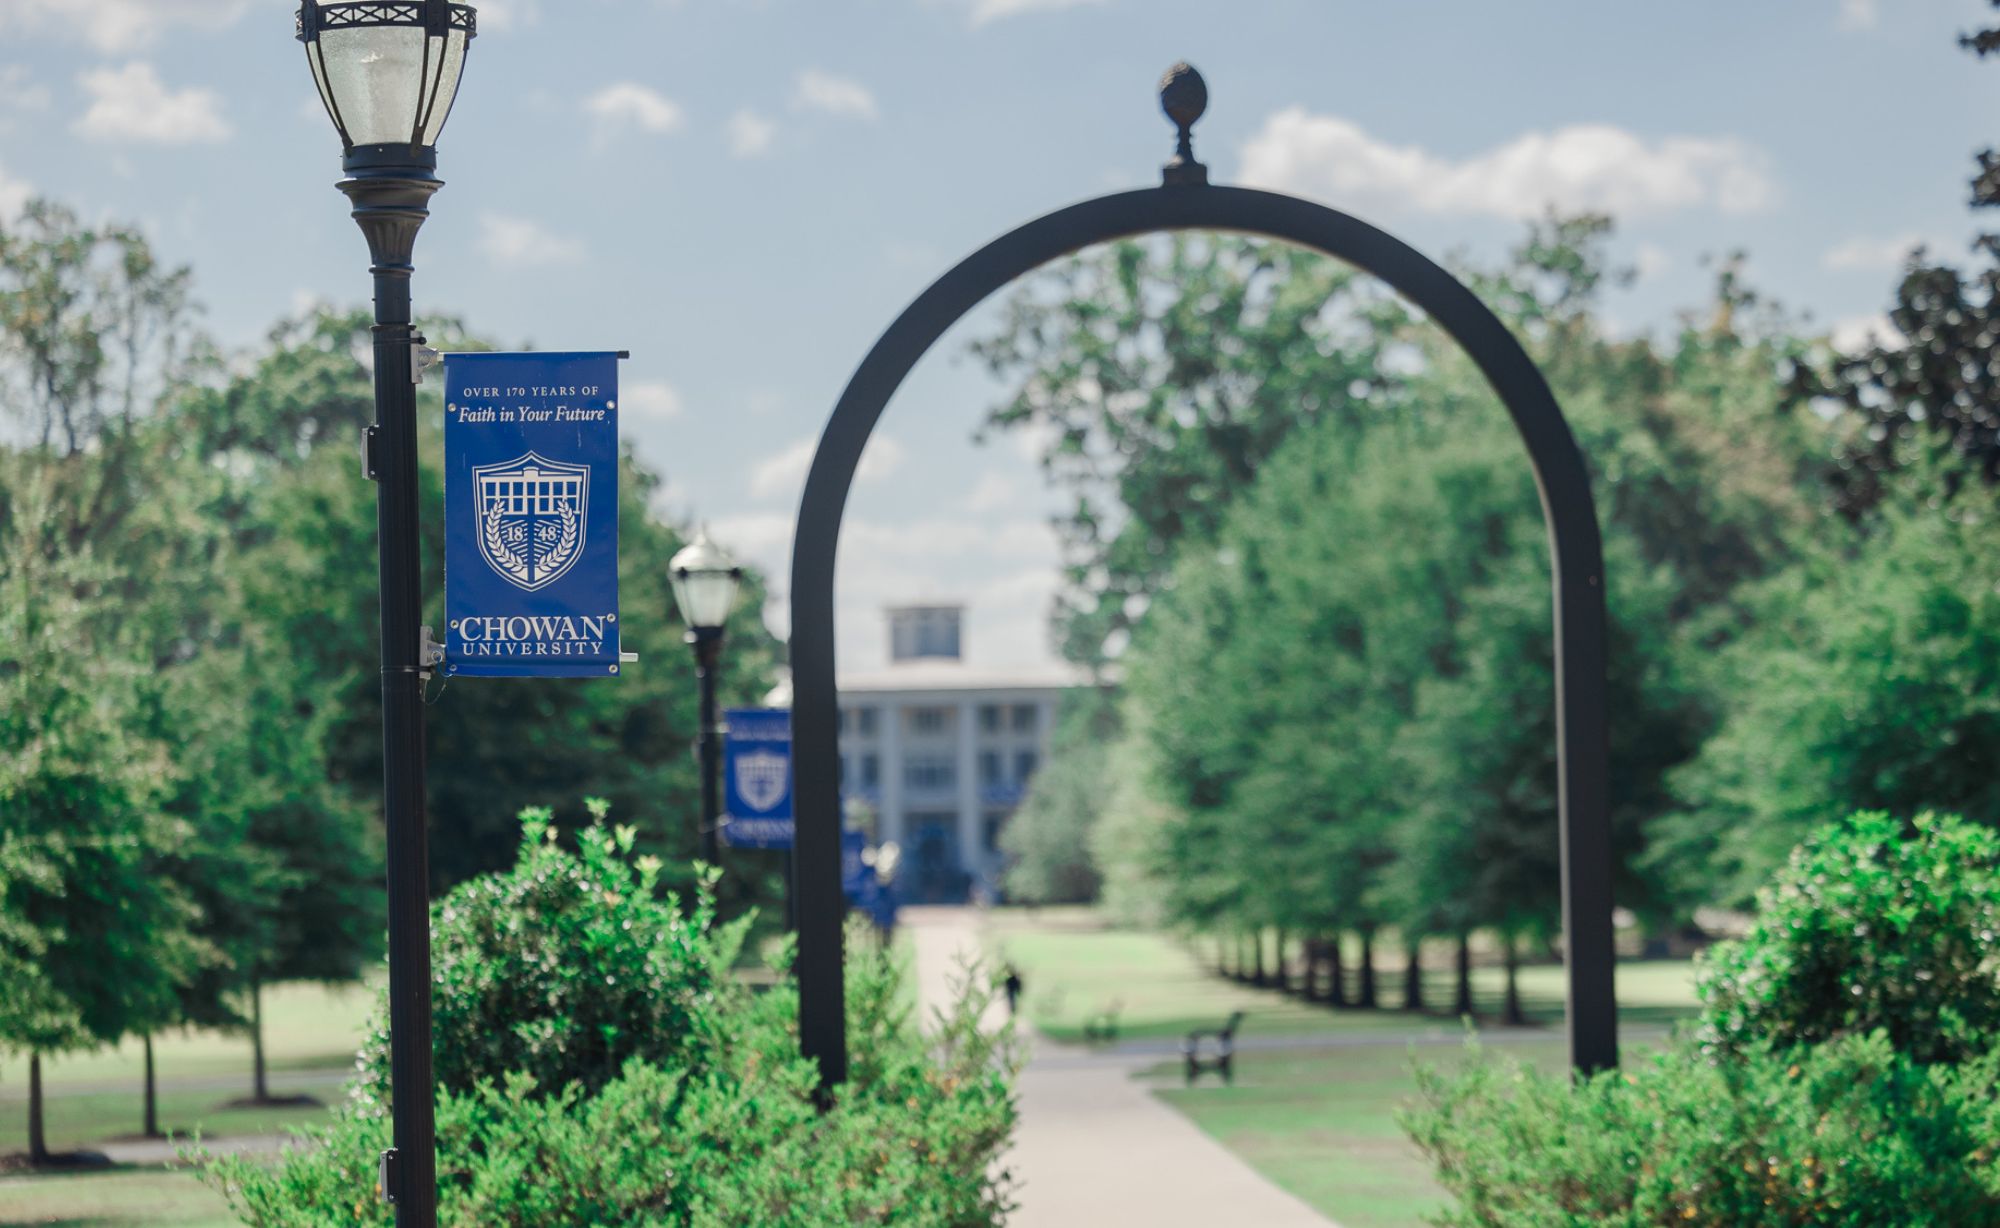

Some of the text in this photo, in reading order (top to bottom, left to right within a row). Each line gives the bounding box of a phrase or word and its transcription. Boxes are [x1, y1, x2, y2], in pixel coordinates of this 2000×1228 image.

[463, 386, 599, 397] OVER 170 YEARS OF
[458, 405, 605, 423] Faith in Your Future
[507, 526, 557, 542] 18 48
[459, 616, 606, 641] CHOWAN
[462, 642, 602, 656] UNIVERSITY
